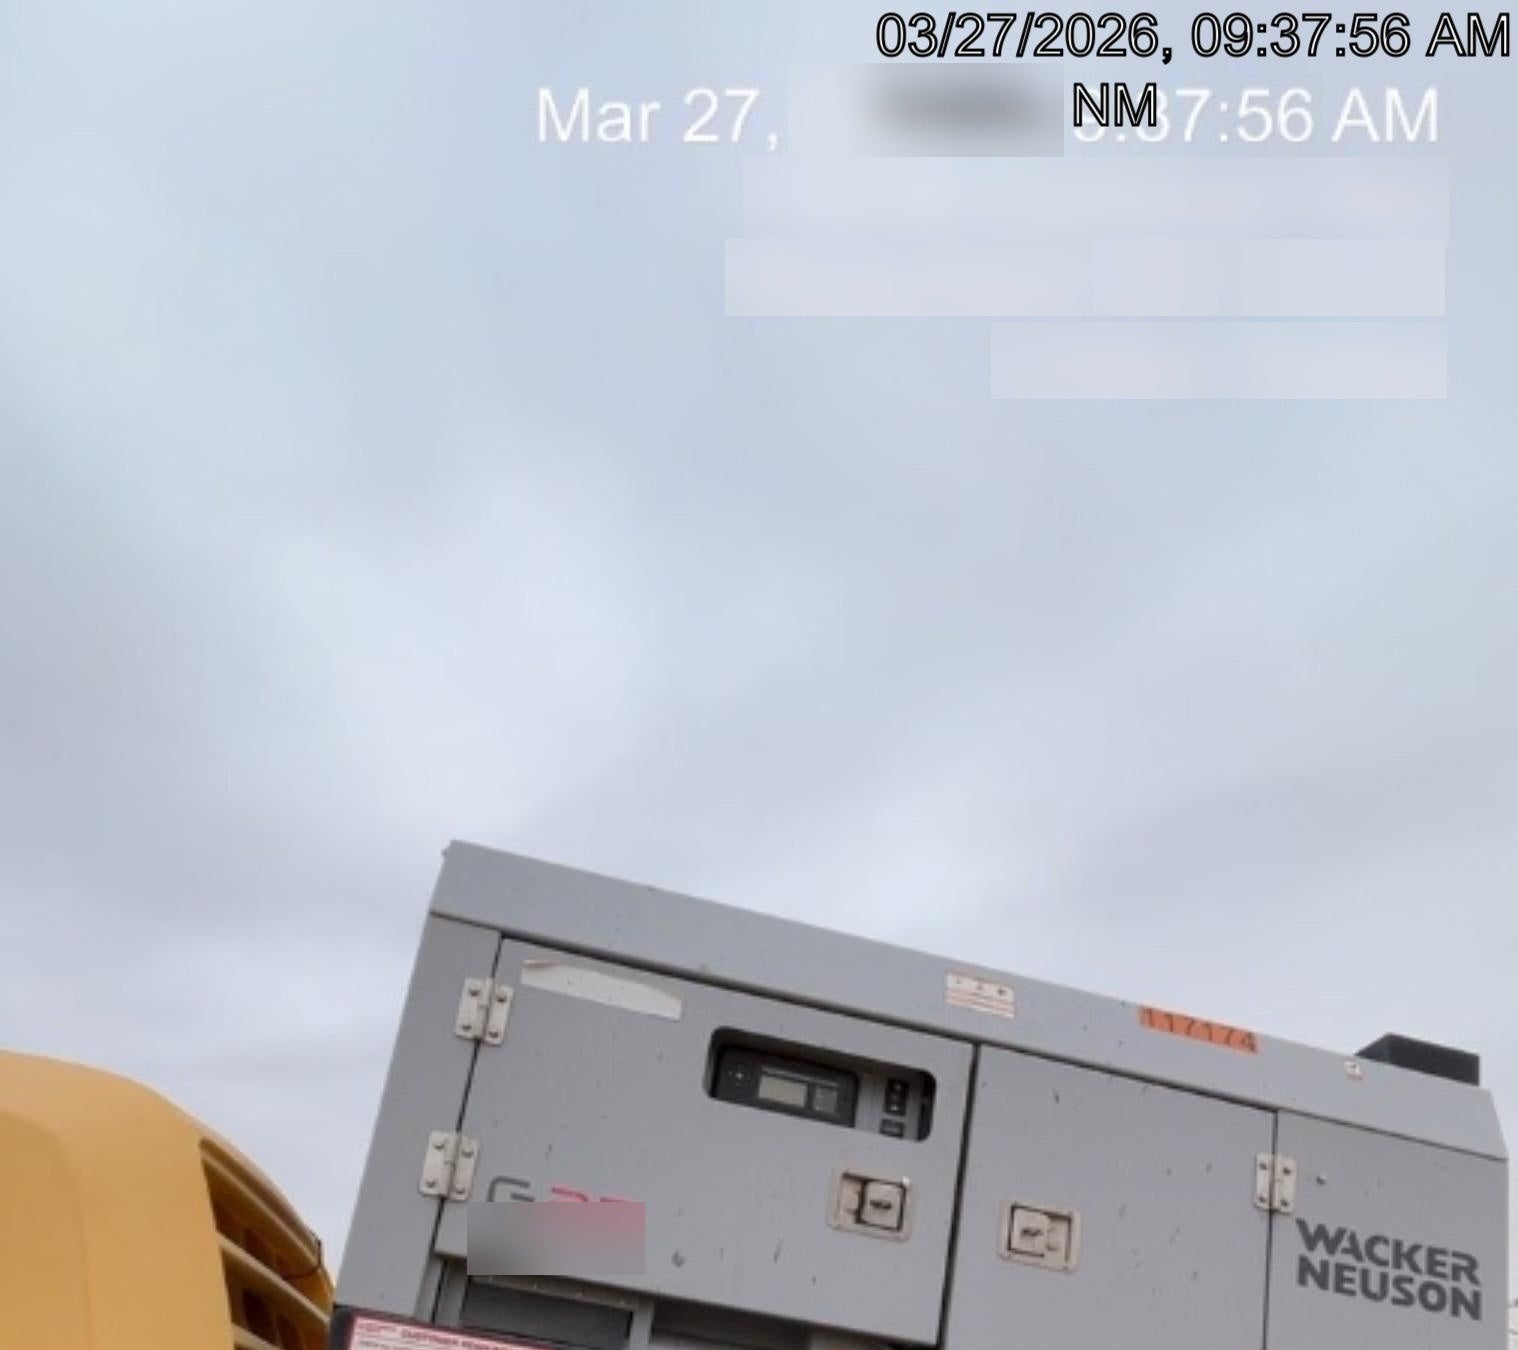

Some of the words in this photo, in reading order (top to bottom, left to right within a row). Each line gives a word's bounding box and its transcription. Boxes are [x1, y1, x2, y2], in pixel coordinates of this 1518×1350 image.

[1142, 1007, 1257, 1054] 117174
[1296, 1217, 1481, 1288] WACKER
[1297, 1254, 1483, 1322] NEUSON
